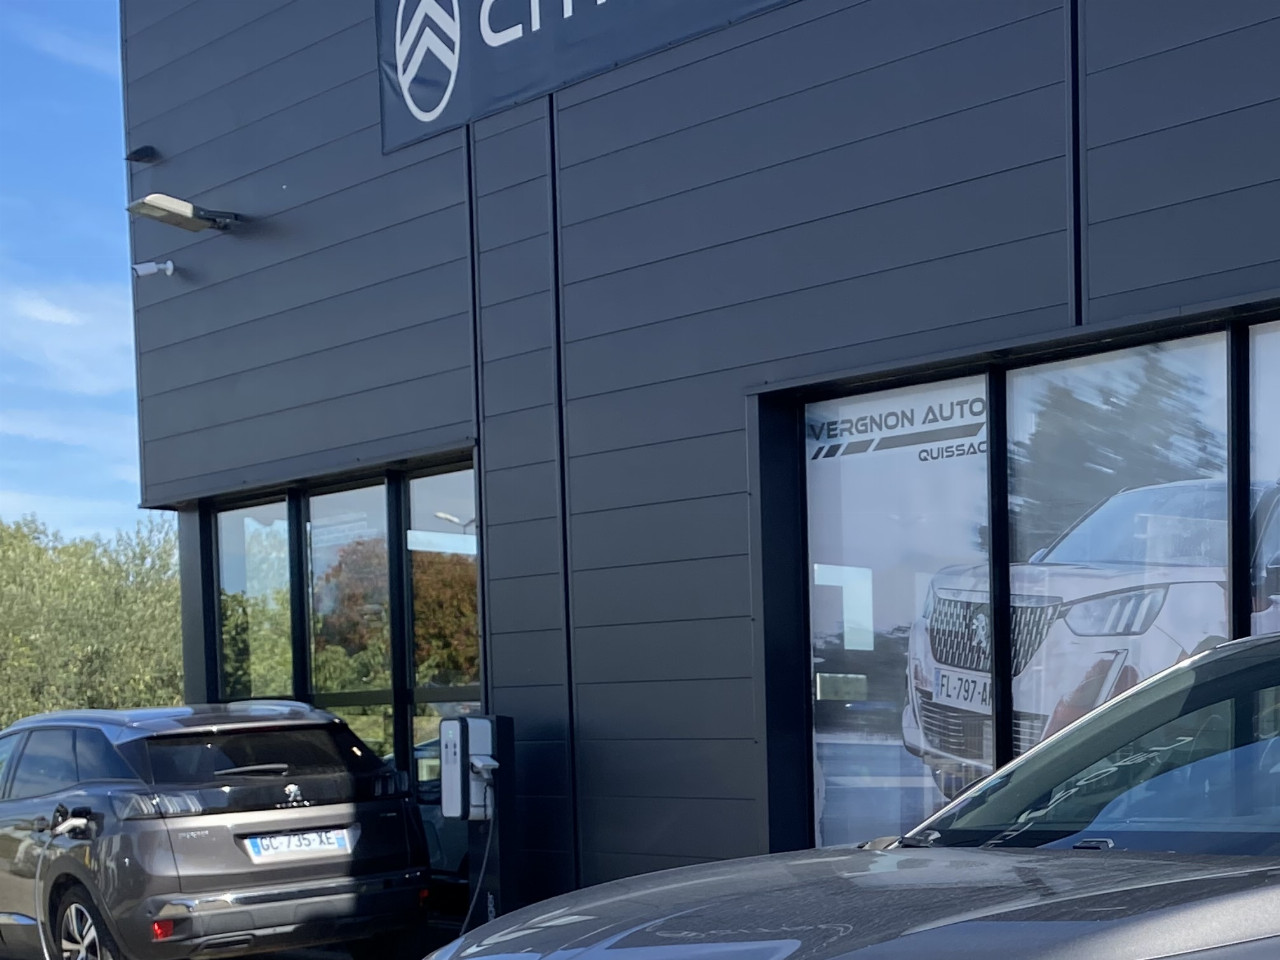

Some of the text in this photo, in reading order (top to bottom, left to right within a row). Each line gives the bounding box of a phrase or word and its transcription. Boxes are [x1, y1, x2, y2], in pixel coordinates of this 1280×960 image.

[810, 397, 986, 441] VERGNON AUTO
[918, 441, 988, 462] QUISSAC
